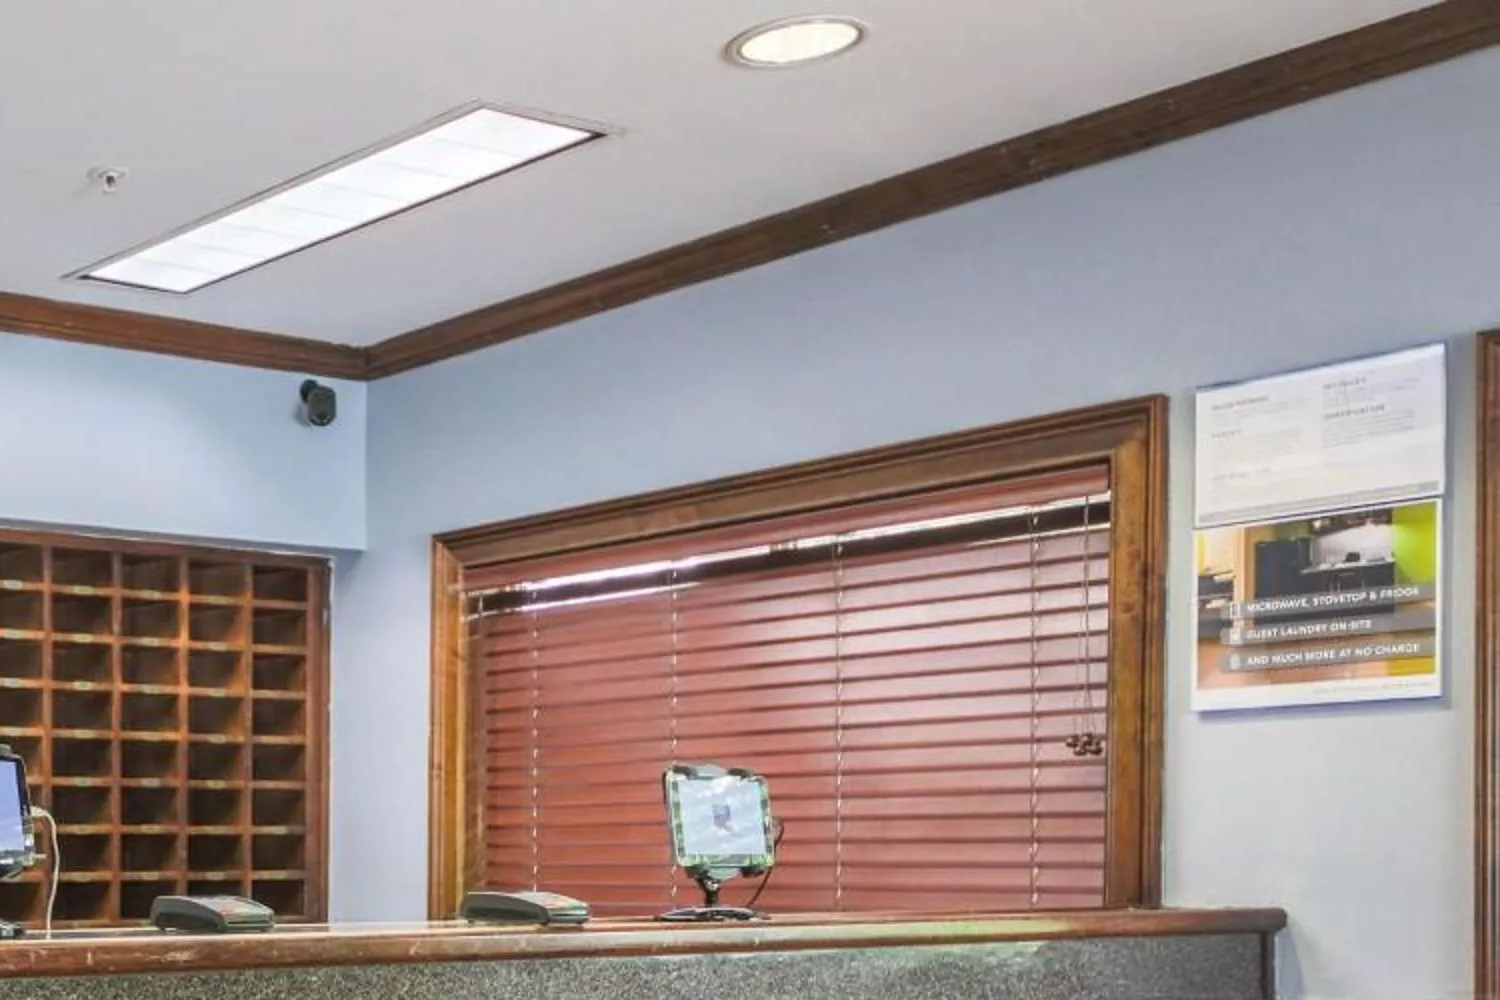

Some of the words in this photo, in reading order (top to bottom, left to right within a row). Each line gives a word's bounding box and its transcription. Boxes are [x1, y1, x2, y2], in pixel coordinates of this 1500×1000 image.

[1313, 592, 1367, 606] STOVETOP
[1369, 591, 1377, 601] &
[1281, 624, 1328, 637] LAUNDRY
[1248, 655, 1269, 665] AND
[1272, 653, 1303, 664] MUCH
[1305, 650, 1336, 661] MORE
[1339, 648, 1353, 657] AT
[1356, 646, 1373, 656] NO
